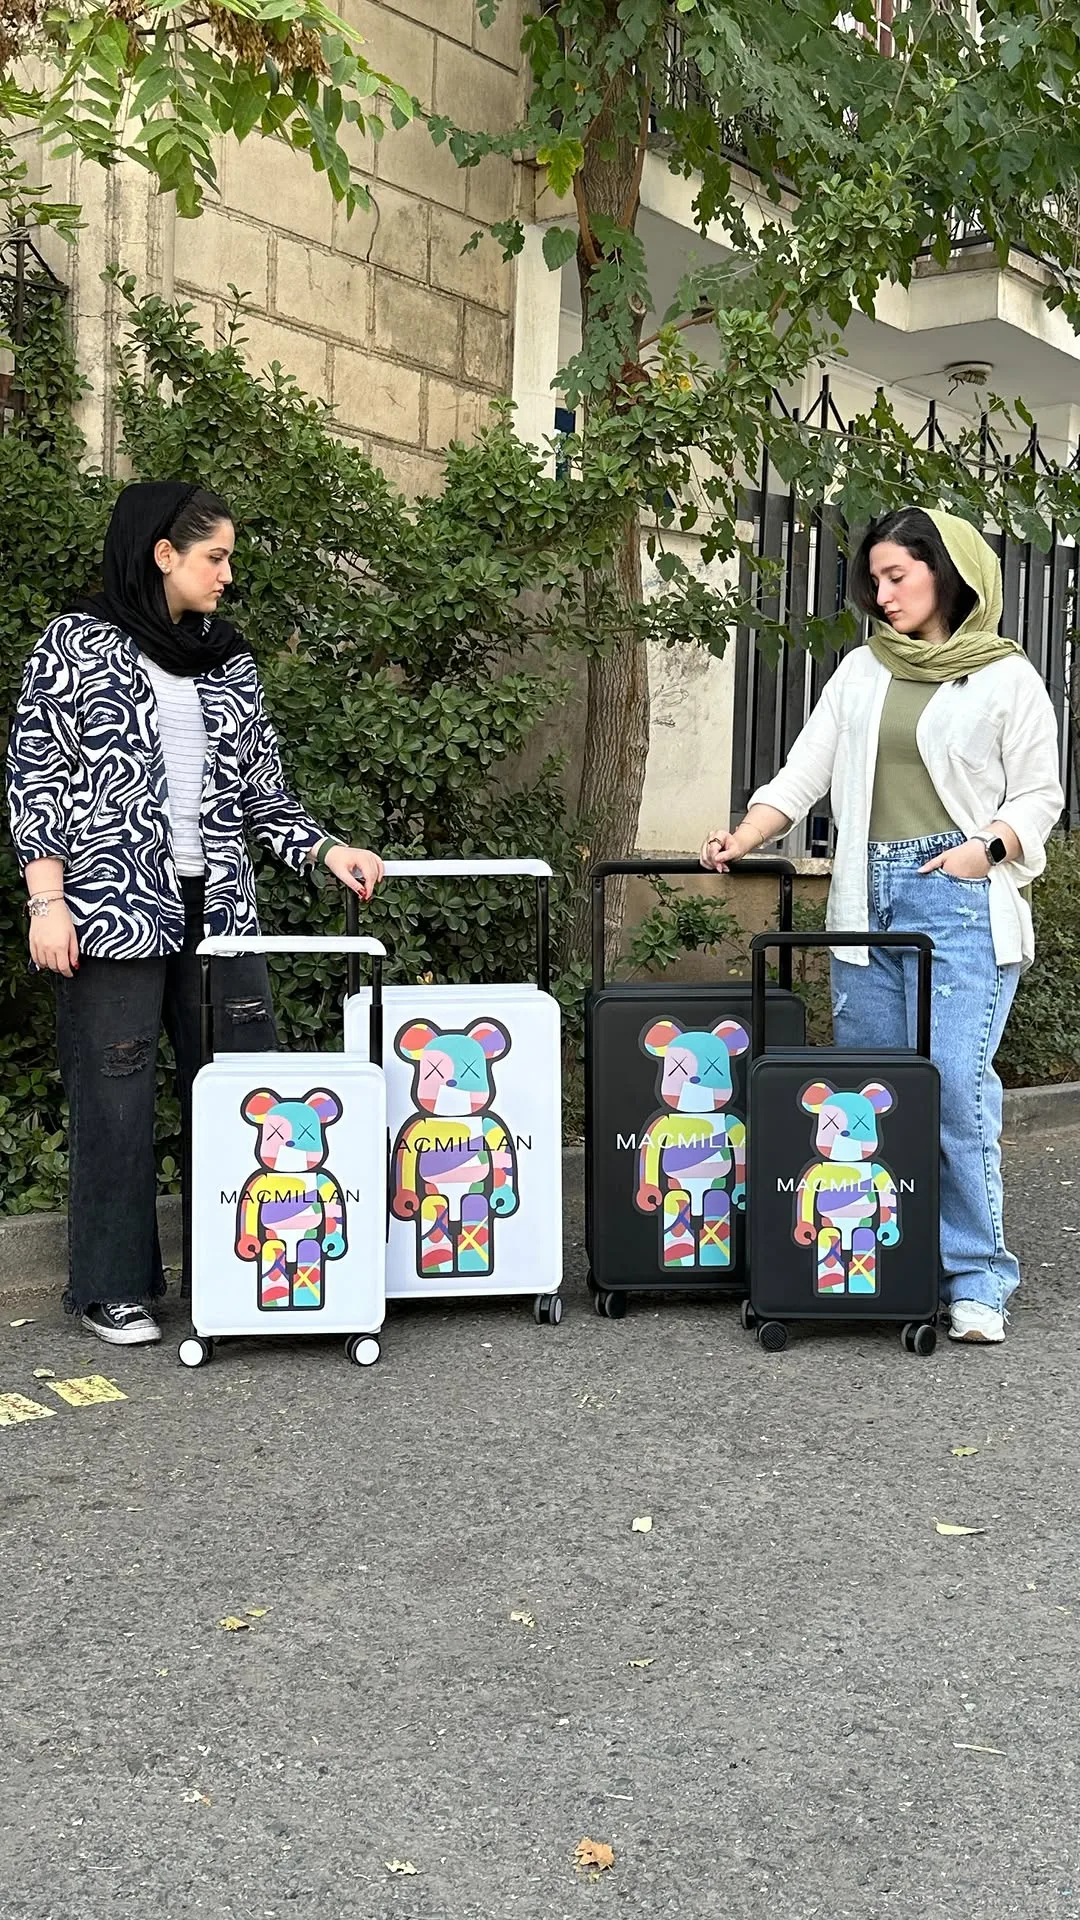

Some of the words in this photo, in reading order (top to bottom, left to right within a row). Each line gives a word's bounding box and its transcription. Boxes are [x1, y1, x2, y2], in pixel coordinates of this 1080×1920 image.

[389, 1135, 532, 1153] ACMILLAN
[616, 1133, 746, 1149] MACMILL
[776, 1178, 915, 1193] MACMILLAN
[220, 1189, 360, 1204] MACMILLAN
